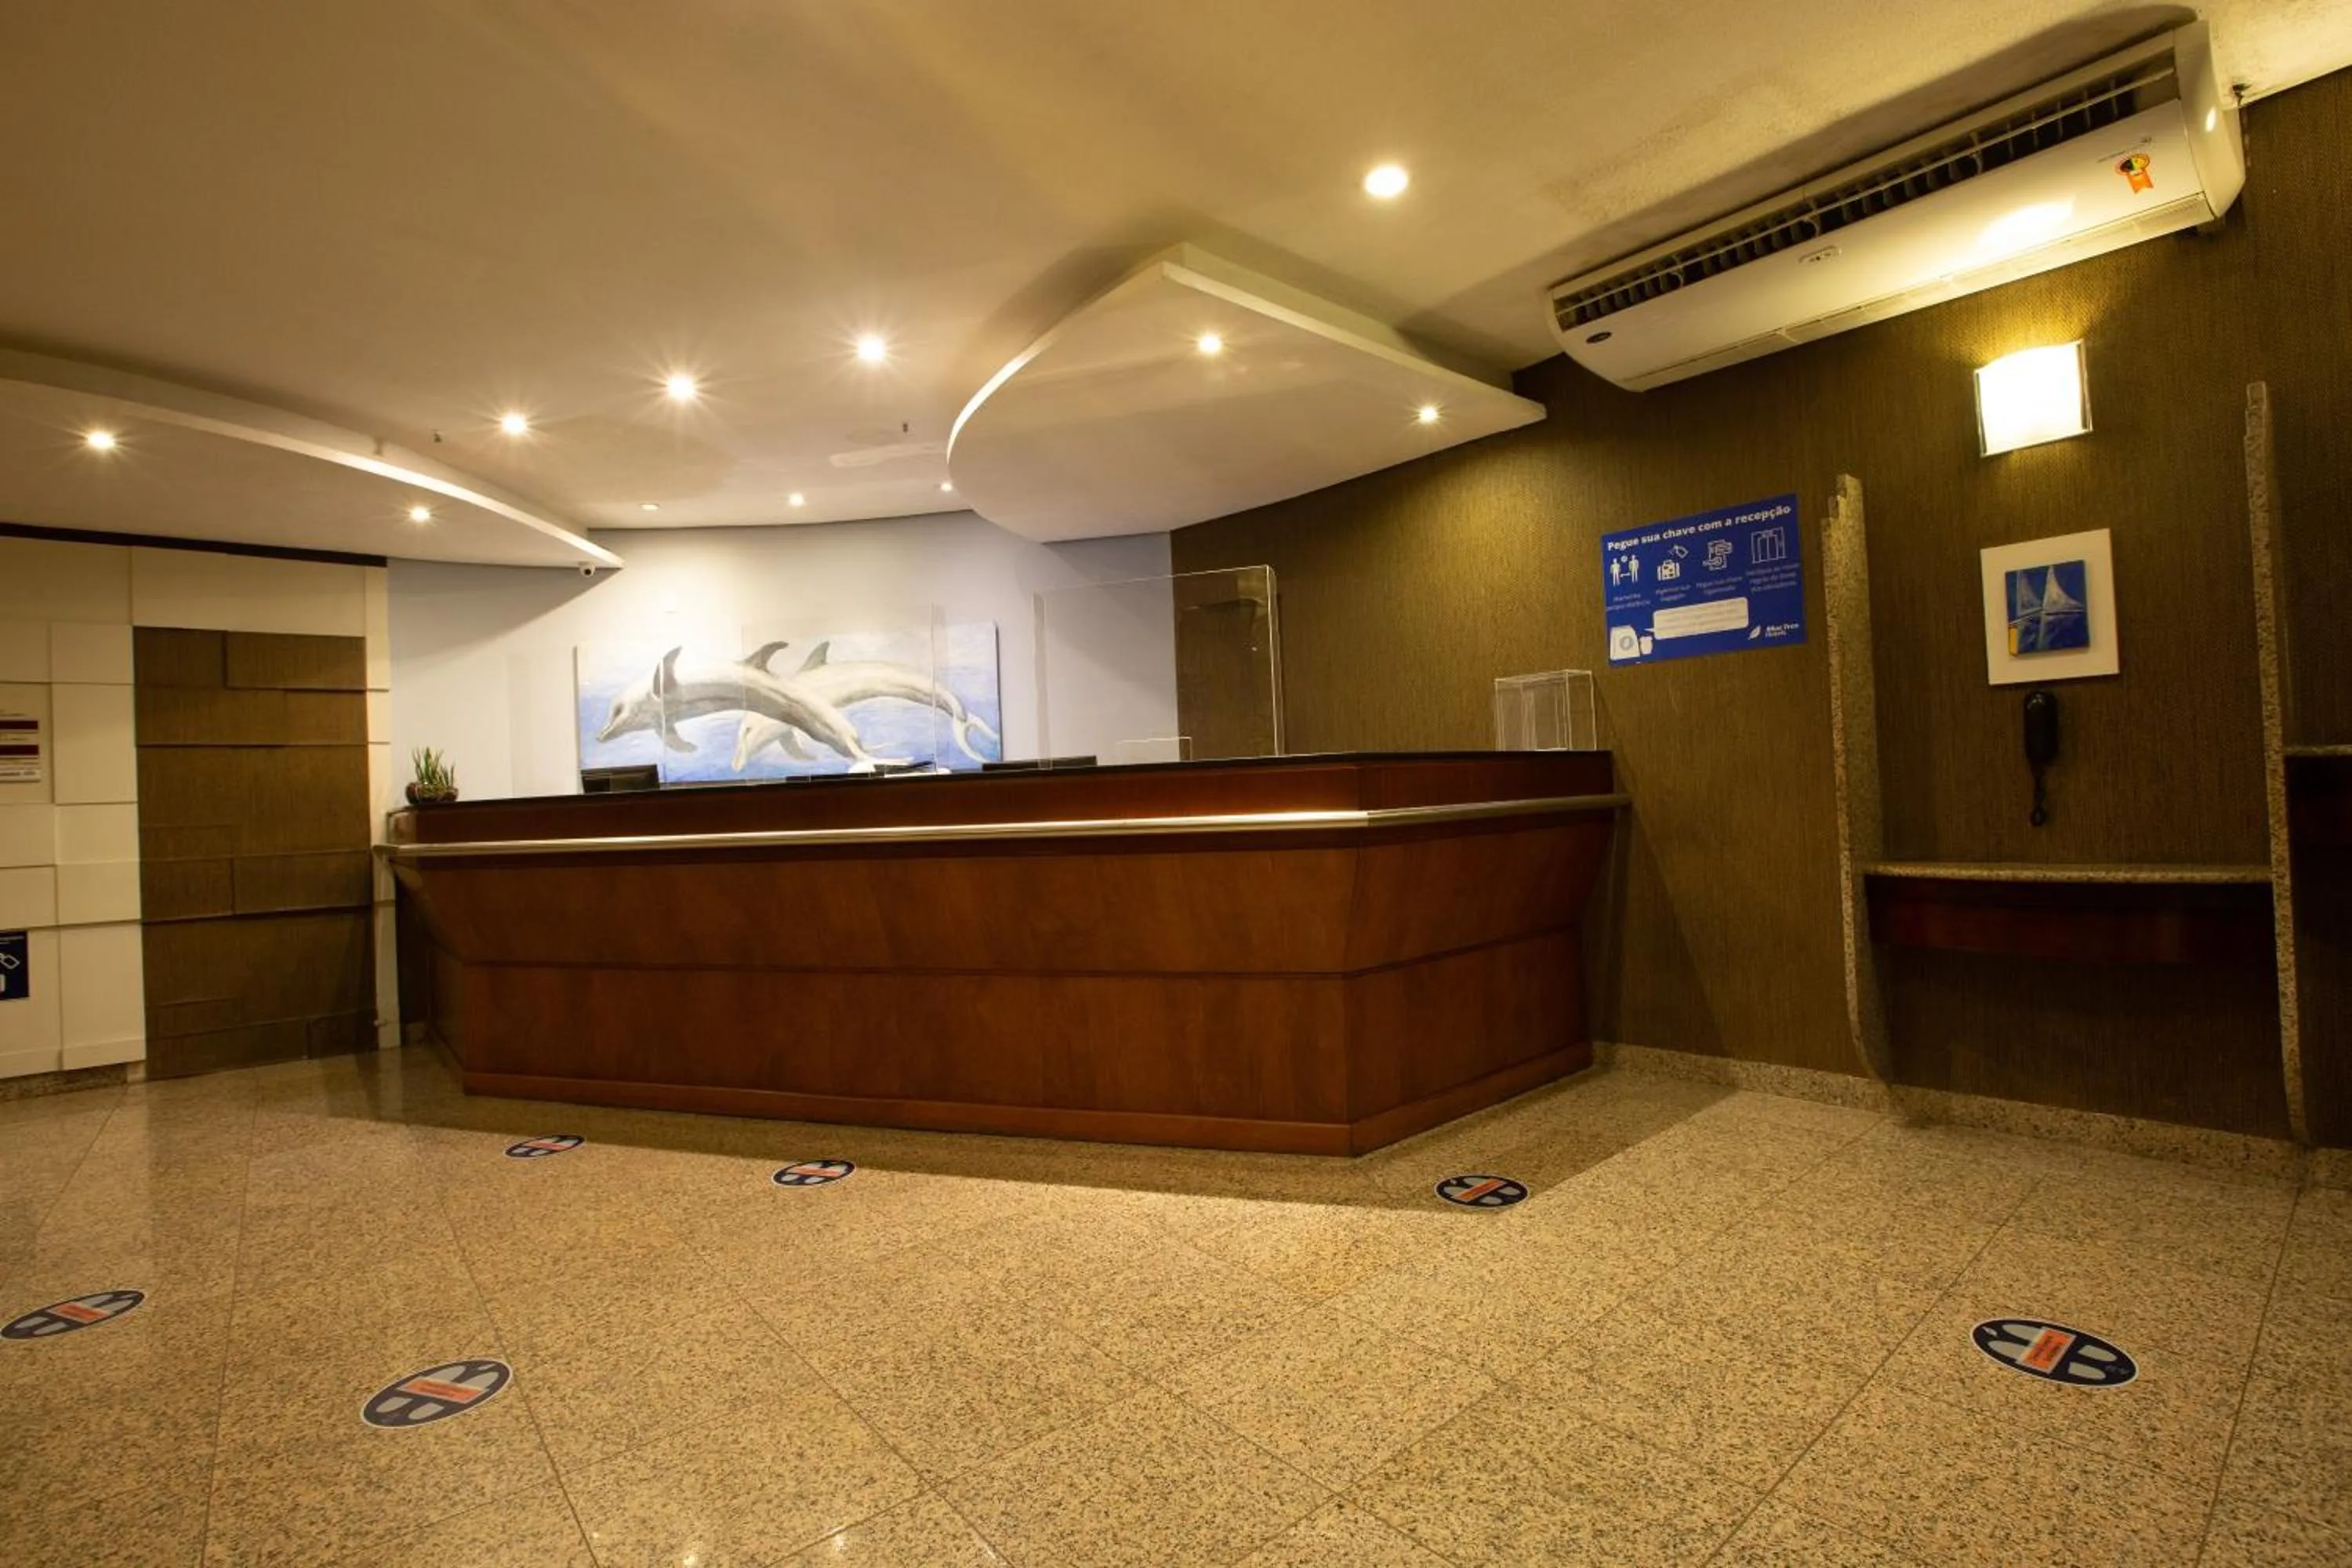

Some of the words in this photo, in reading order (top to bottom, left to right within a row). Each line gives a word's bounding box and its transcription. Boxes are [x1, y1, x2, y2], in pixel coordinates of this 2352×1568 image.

[1607, 537, 1639, 551] Pegue
[1641, 533, 1661, 544] sua
[1662, 526, 1696, 539] chave
[1697, 520, 1722, 532] com
[1725, 517, 1732, 527] a
[1735, 505, 1792, 524] recepção
